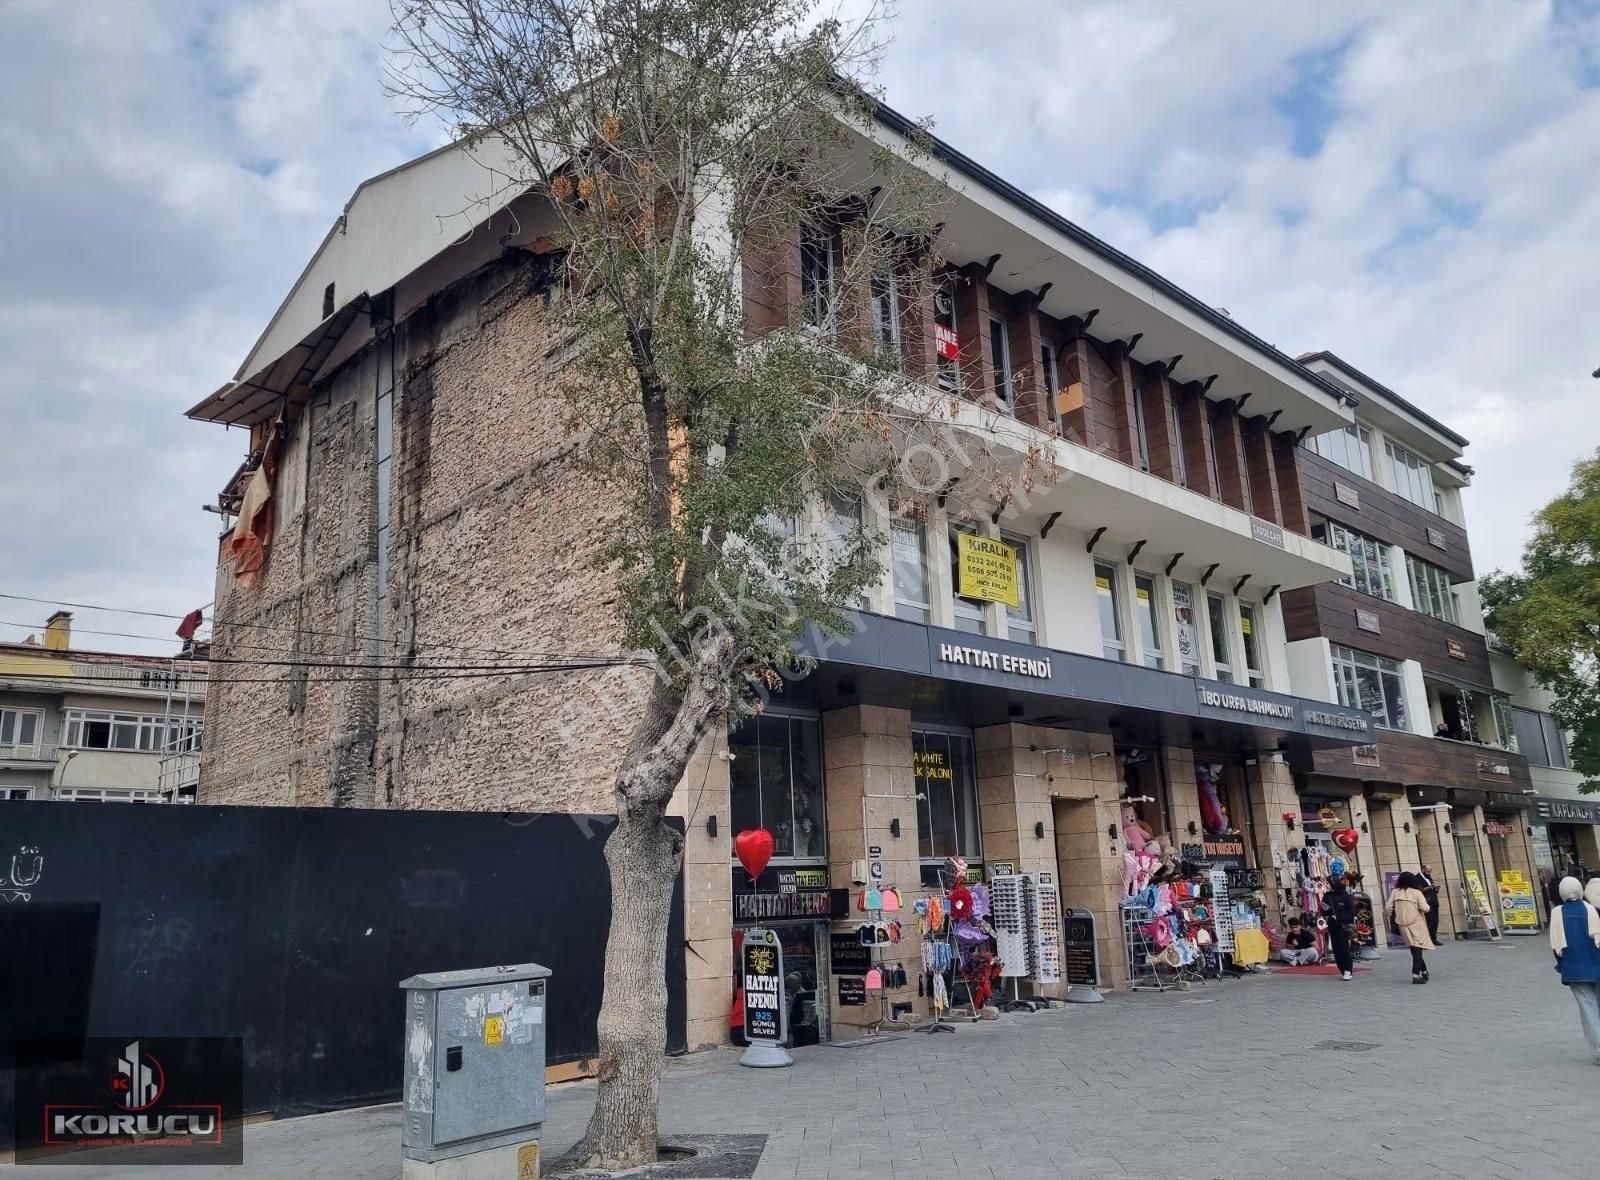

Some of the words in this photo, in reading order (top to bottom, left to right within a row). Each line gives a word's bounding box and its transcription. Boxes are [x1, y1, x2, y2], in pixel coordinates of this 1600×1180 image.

[940, 643, 999, 670] HATTAT
[1002, 655, 1052, 679] EFENDİ
[1201, 686, 1220, 705] İBO
[1221, 694, 1246, 712] URFA
[746, 975, 779, 992] HATTAT
[747, 992, 778, 1010] EFENDİ
[755, 1011, 772, 1020] 925
